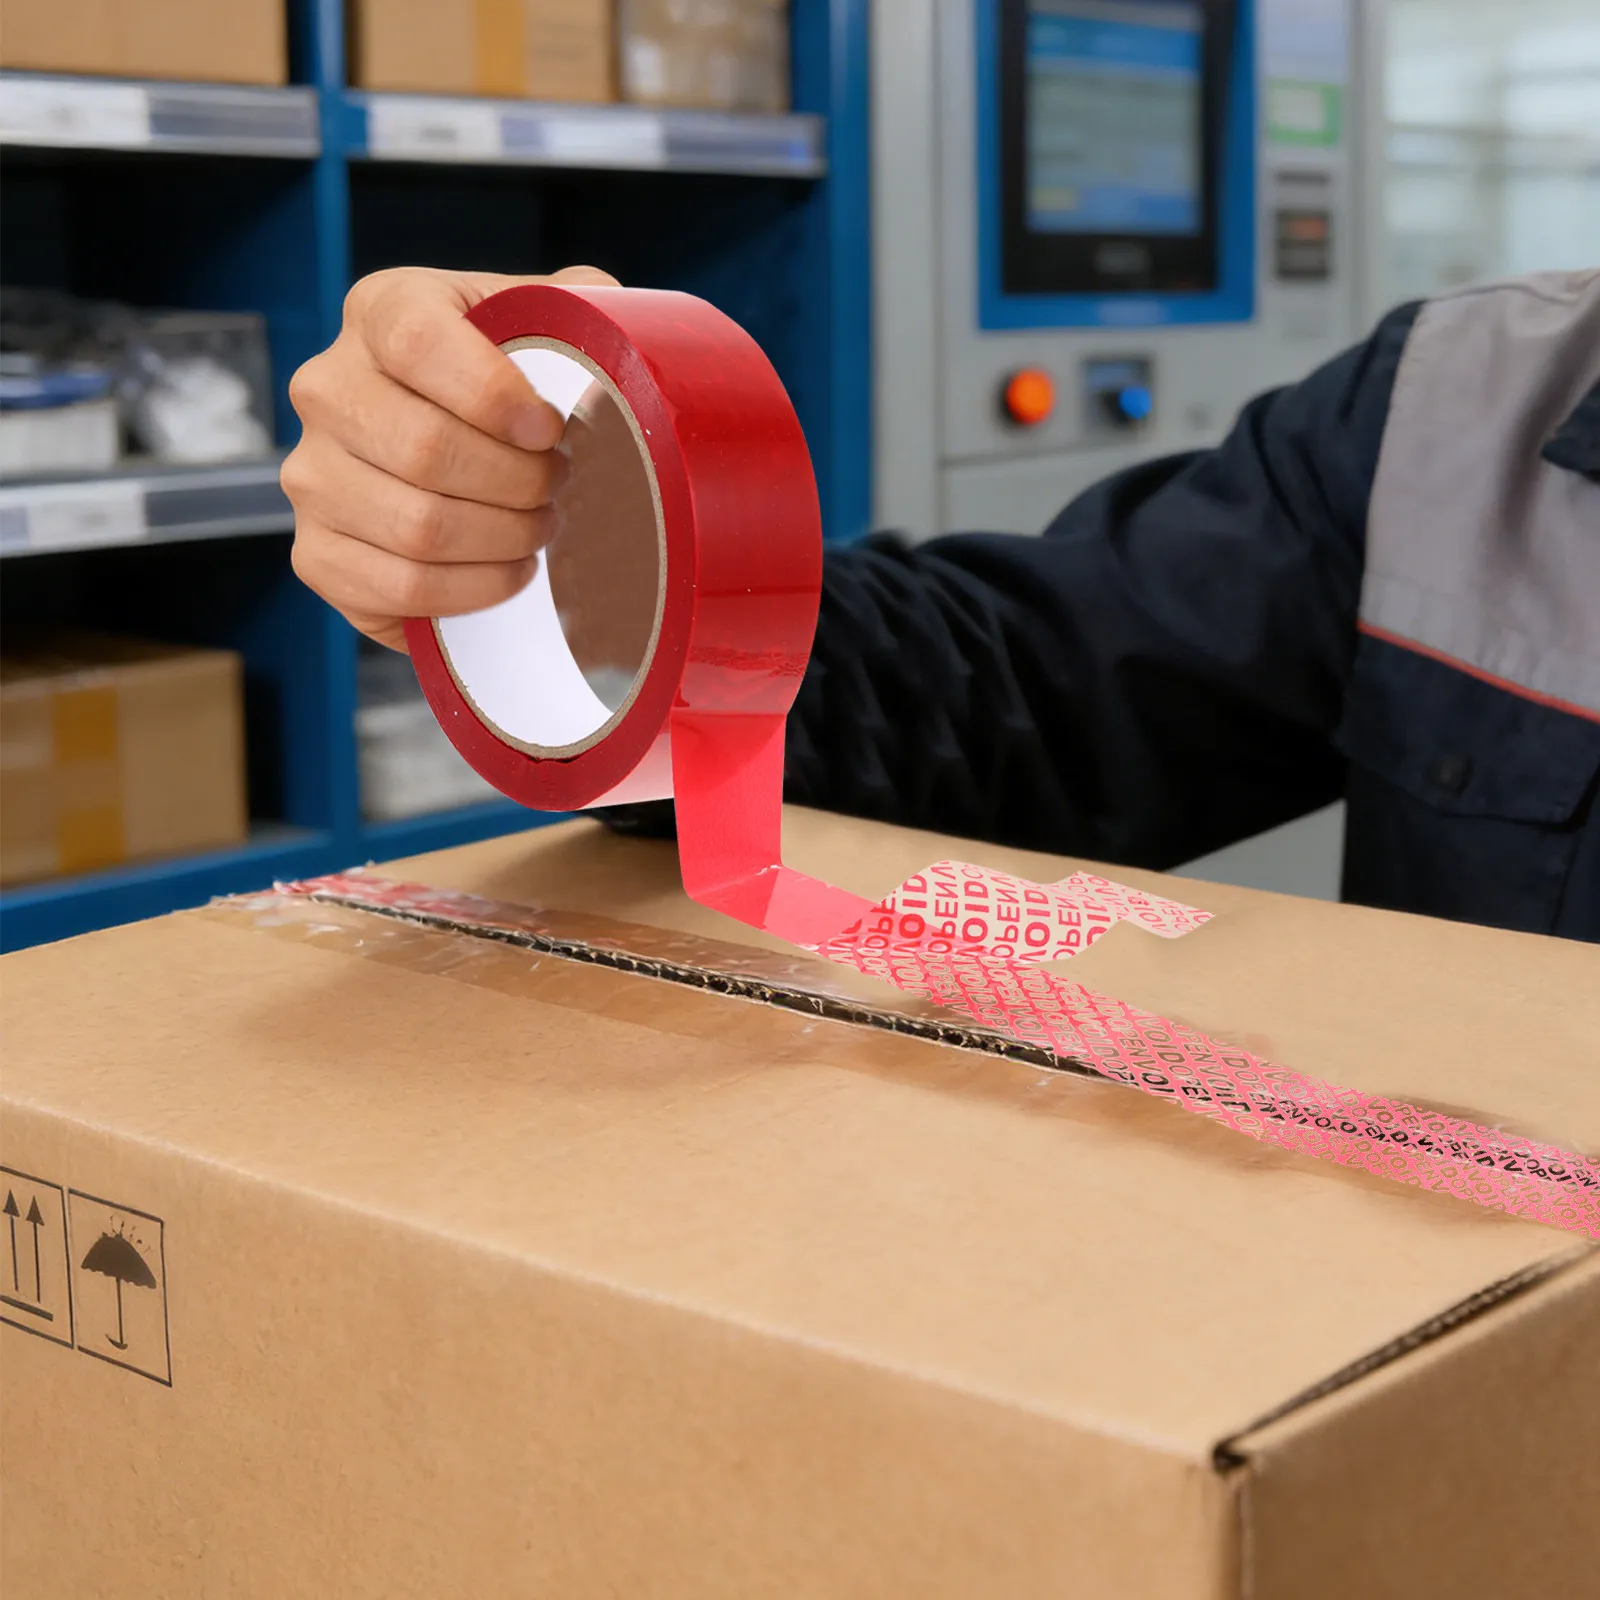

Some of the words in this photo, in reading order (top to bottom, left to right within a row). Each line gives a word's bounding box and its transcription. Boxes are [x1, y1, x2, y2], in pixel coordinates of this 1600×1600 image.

[954, 964, 999, 1005] VOID
[1017, 968, 1061, 1011] VOID
[1073, 1012, 1120, 1057] VOID
[1106, 1018, 1153, 1058] OPEN
[1135, 1018, 1186, 1063] VOID
[1367, 1098, 1409, 1143] VOID
